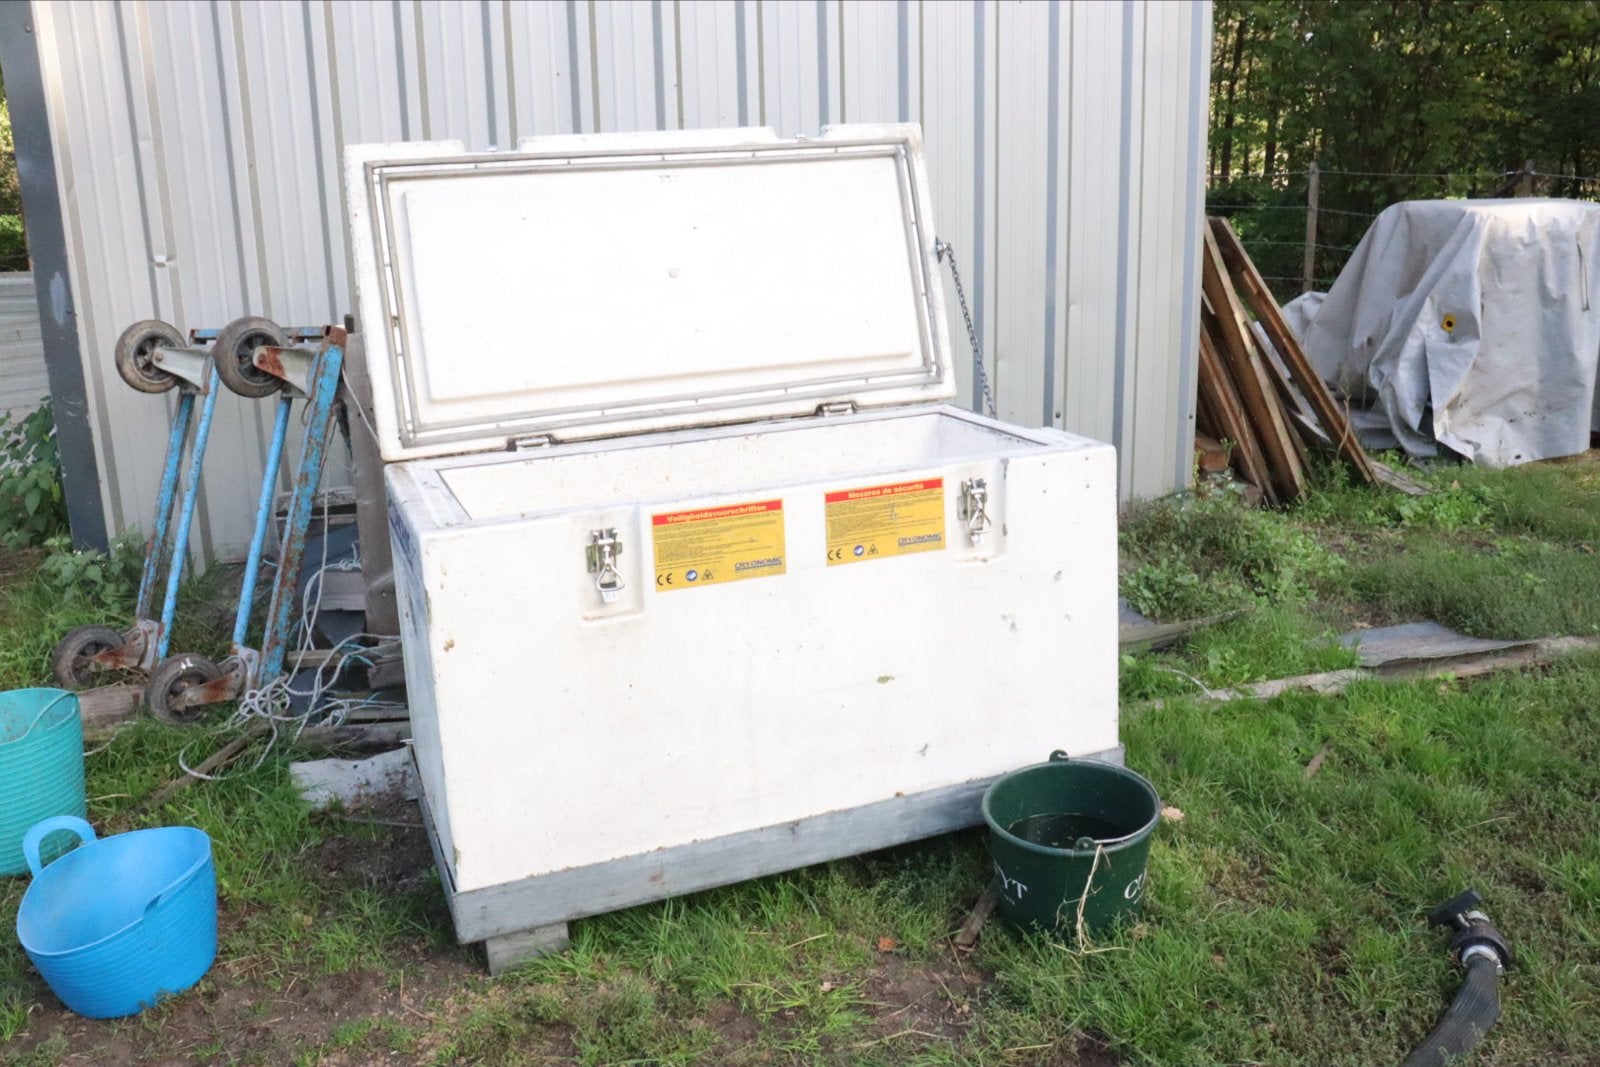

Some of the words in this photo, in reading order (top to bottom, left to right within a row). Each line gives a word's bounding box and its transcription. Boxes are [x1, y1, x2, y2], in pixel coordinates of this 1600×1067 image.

[848, 489, 880, 499] Mesures
[882, 486, 892, 495] de
[667, 504, 767, 524] Veiligheidsvoorschriften
